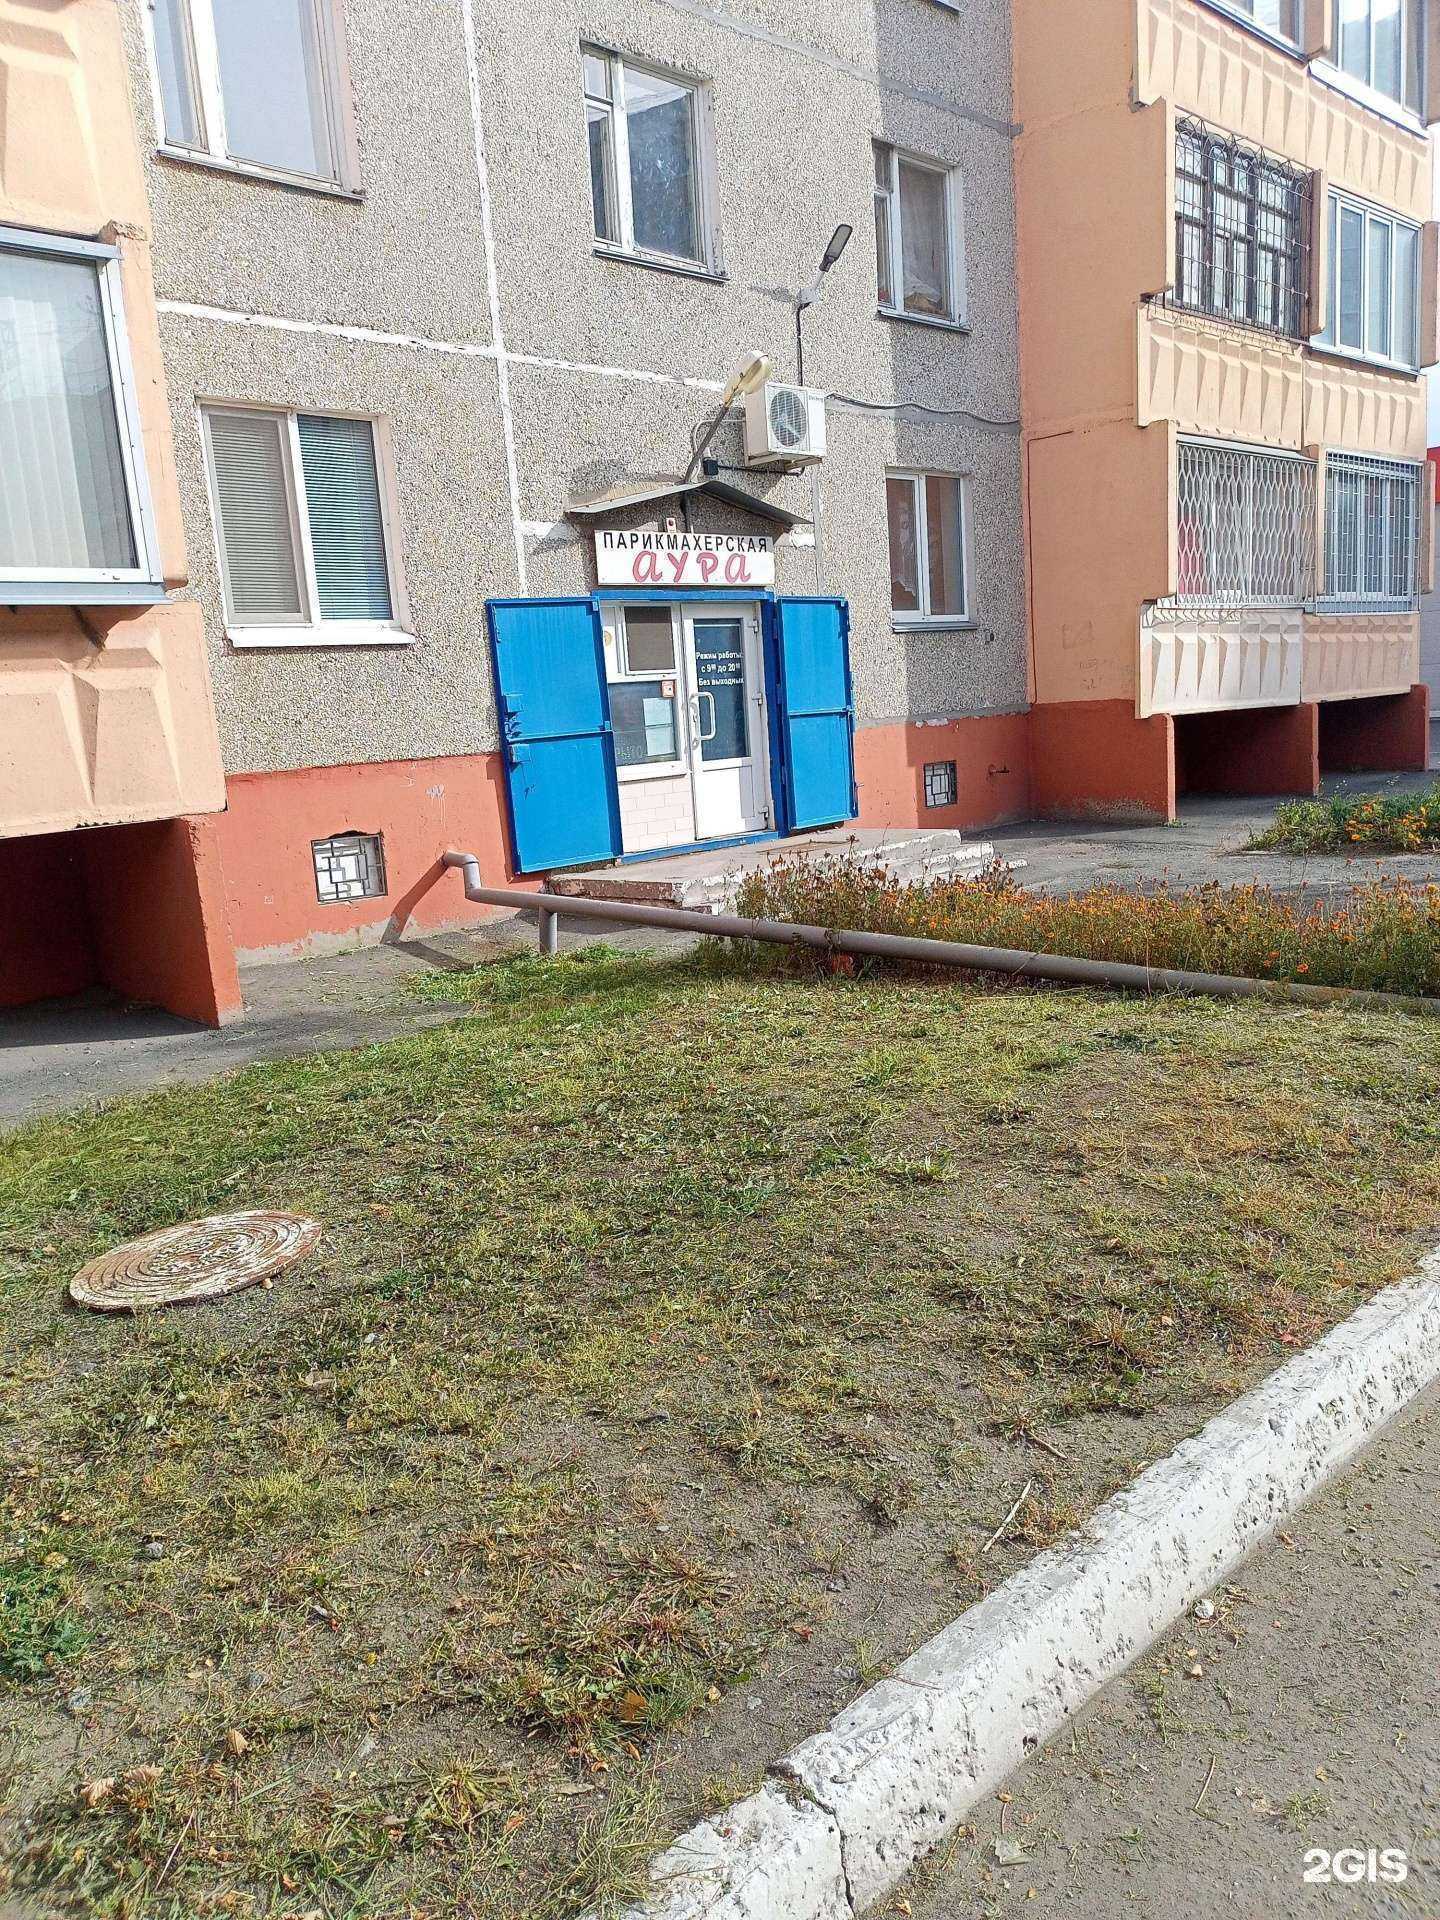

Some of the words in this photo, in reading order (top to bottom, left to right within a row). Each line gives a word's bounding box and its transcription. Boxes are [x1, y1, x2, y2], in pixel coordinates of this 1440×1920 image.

[603, 532, 767, 553] ПАРИКМАХЕРСКАЯ
[696, 651, 717, 660] Режим
[717, 665, 727, 674] до
[698, 677, 711, 686] Без
[711, 677, 745, 686] выходных
